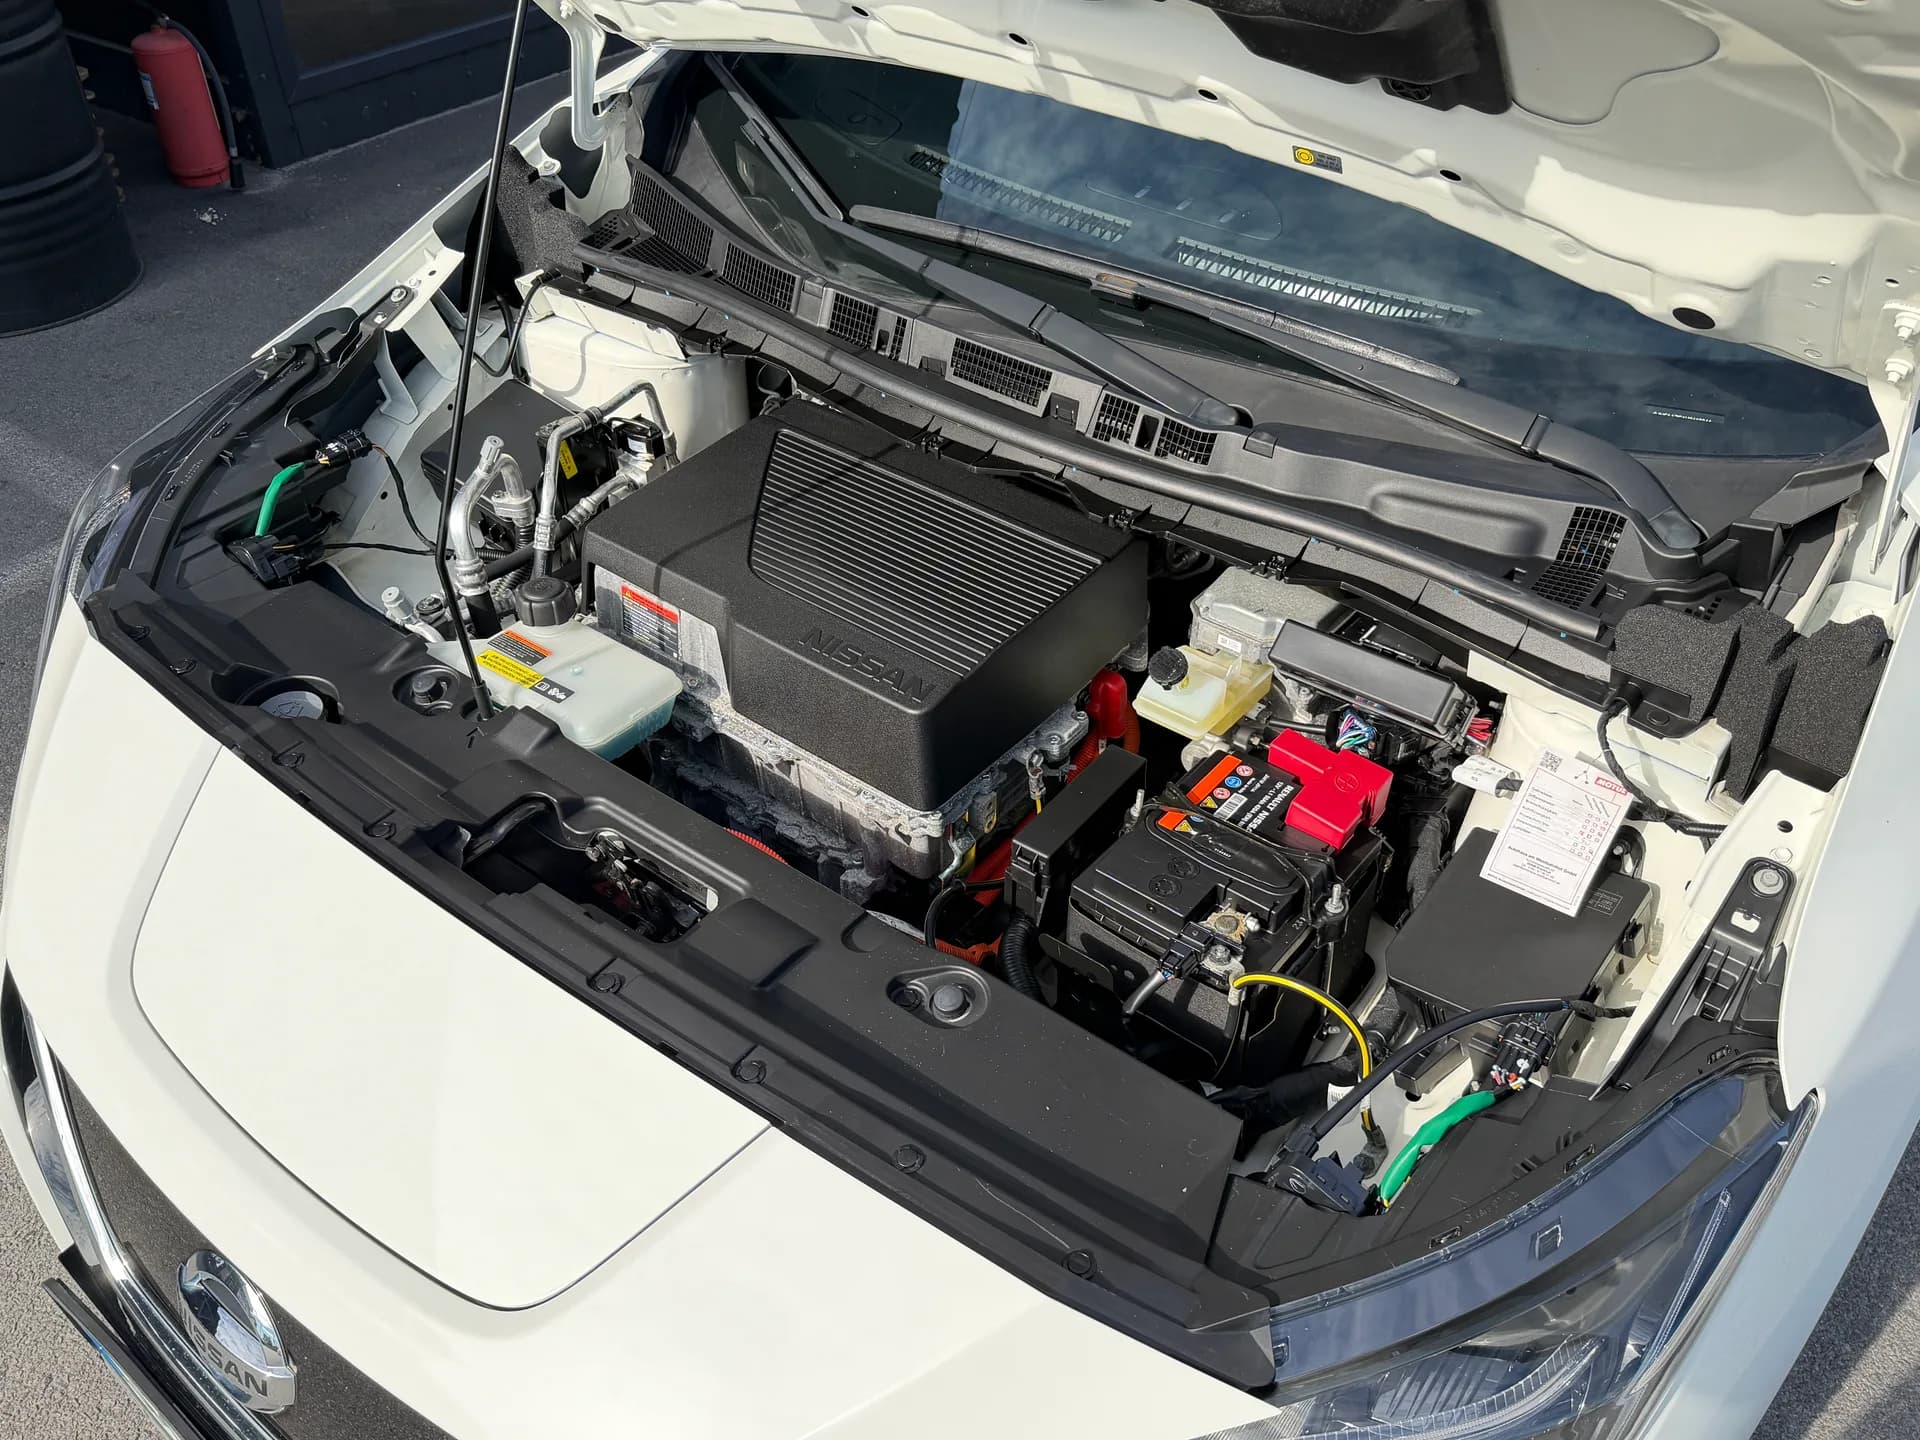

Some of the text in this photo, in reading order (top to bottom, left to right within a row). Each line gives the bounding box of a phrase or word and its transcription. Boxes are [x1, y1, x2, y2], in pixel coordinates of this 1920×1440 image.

[798, 626, 937, 704] NISSAN
[1266, 784, 1294, 811] RENAULT
[183, 1307, 268, 1397] NISSAN
